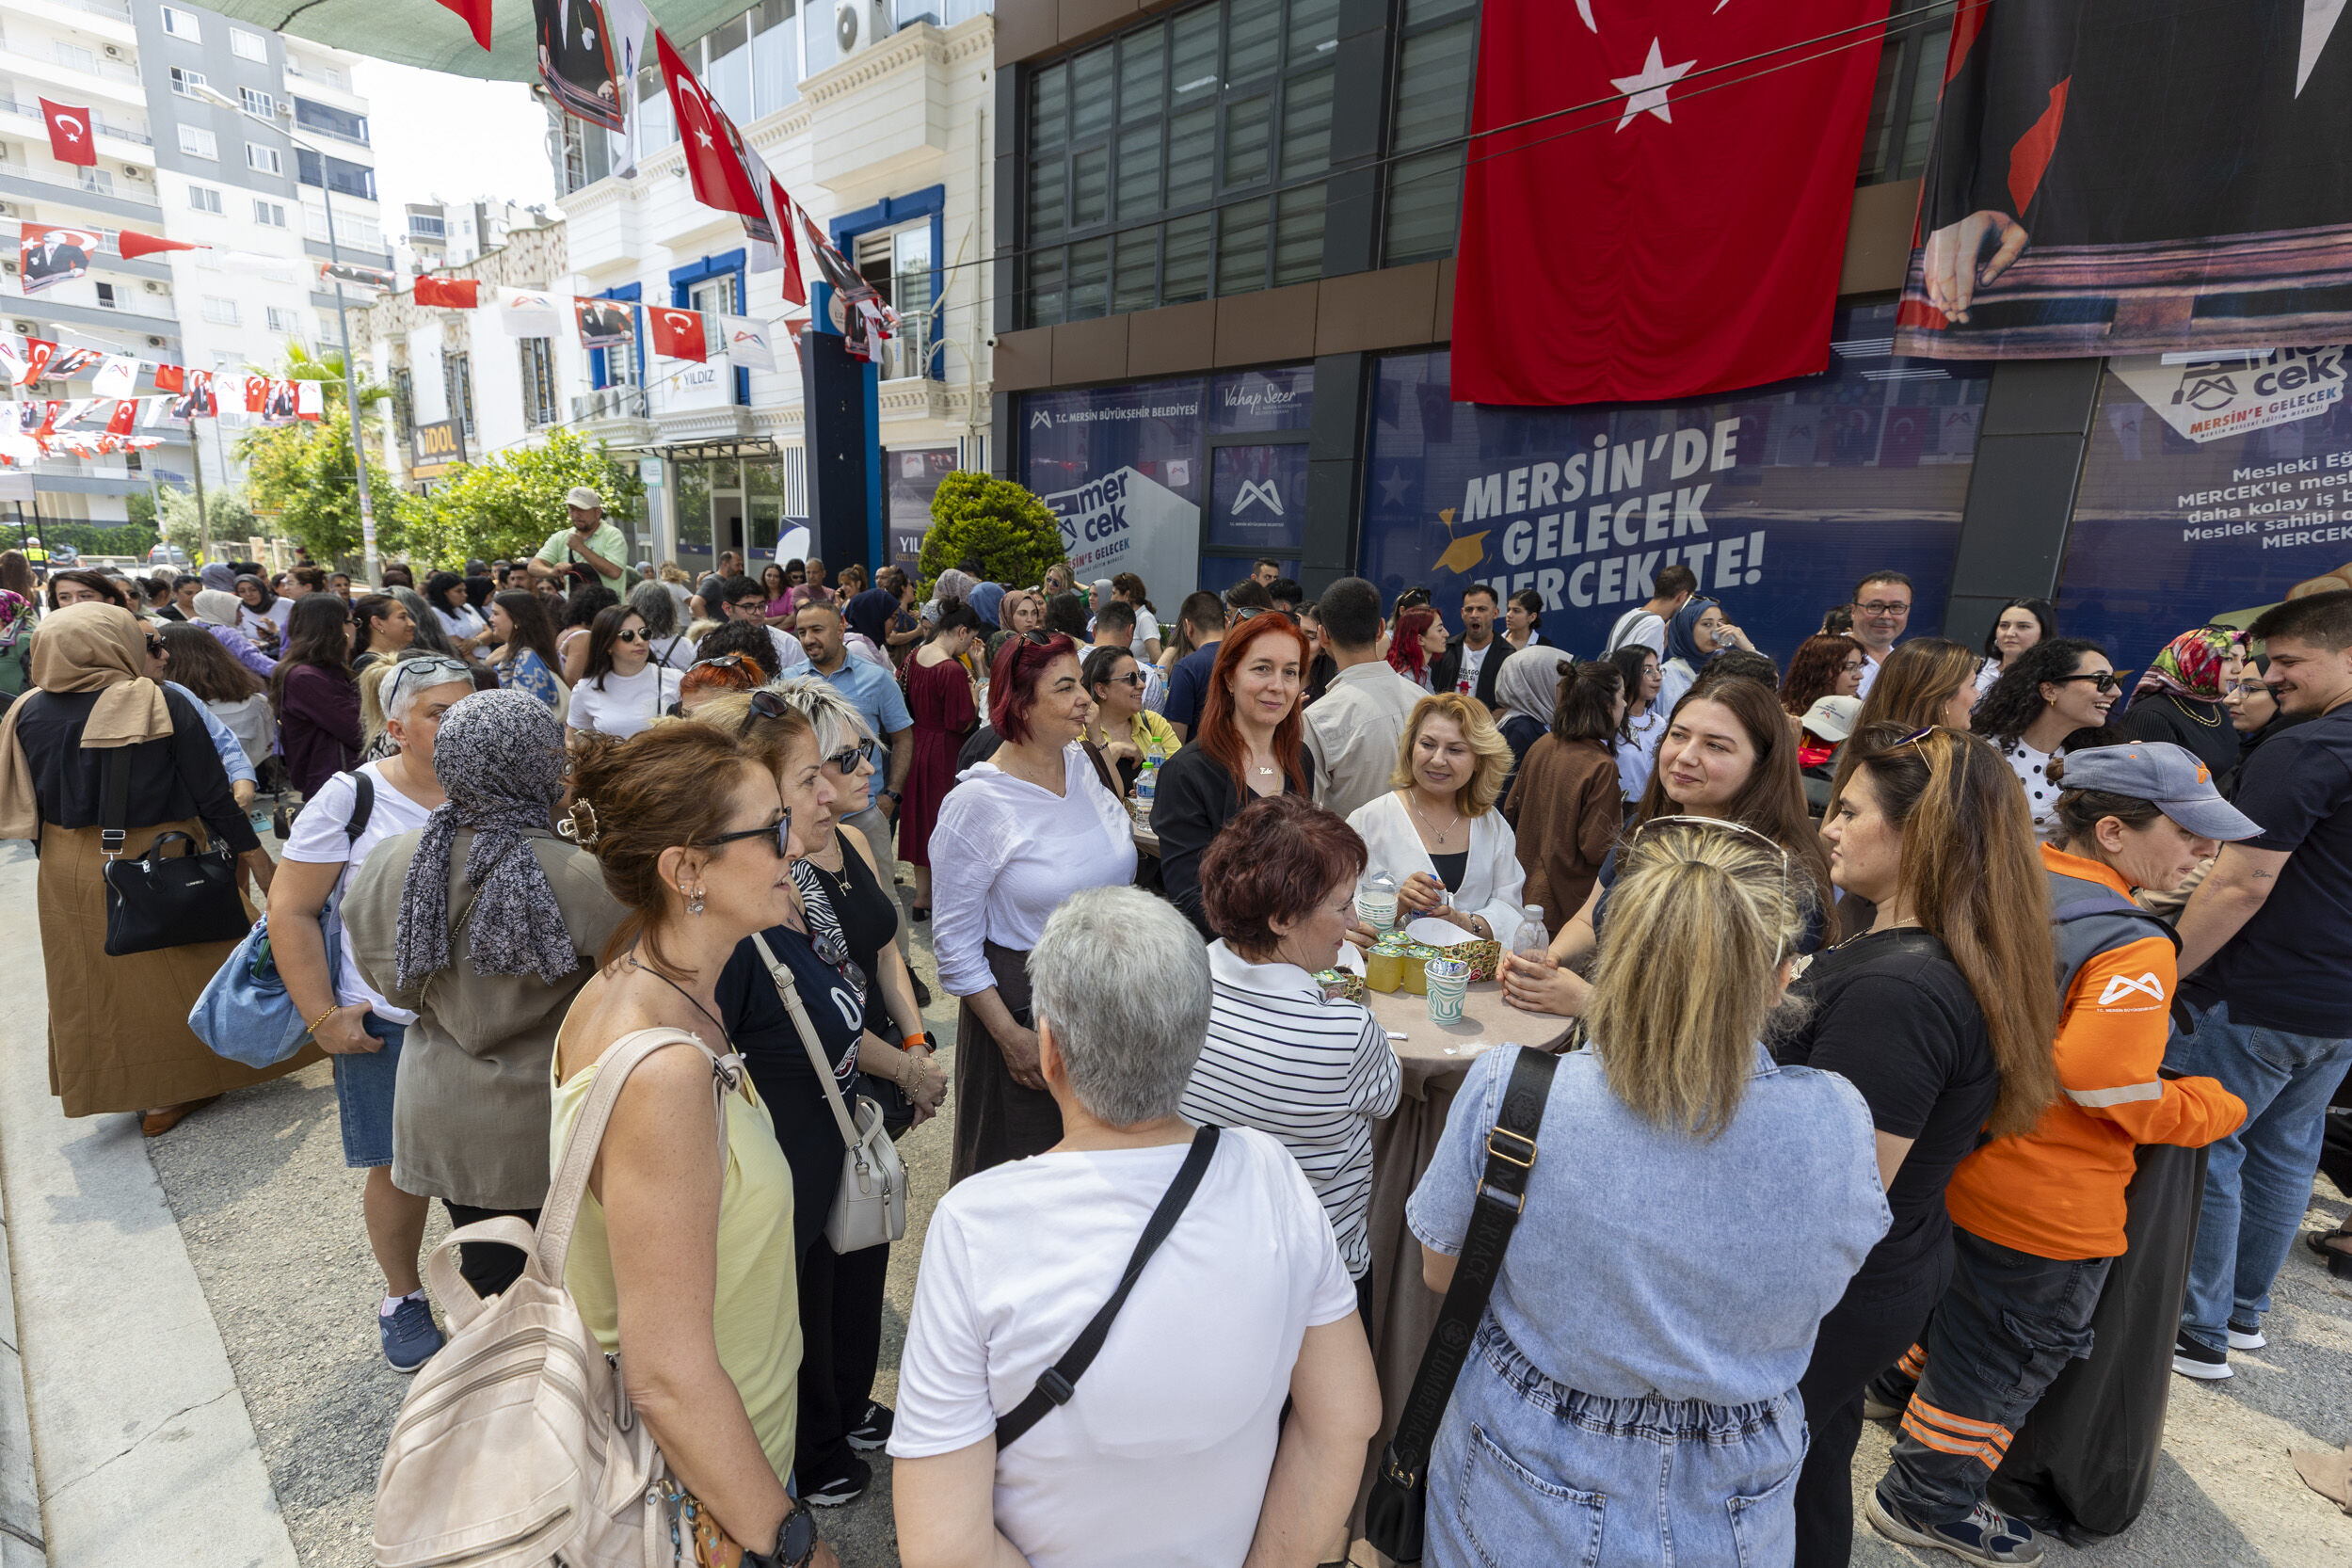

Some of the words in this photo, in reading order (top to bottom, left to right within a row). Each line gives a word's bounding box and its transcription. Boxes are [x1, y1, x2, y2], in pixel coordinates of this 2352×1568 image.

[683, 369, 714, 385] YILDIZ
[2253, 355, 2340, 397] cek
[1069, 409, 1098, 423] MERSİN
[1099, 405, 1150, 422] BÜYÜKŞEHİR
[1151, 402, 1198, 417] BELEDİYESİ
[1224, 384, 1262, 415] Vahap
[2189, 406, 2263, 435] MERSİN'E
[2268, 386, 2338, 414] GELECEK
[2232, 456, 2318, 483] Mesleki
[1079, 472, 1128, 515] mer
[2177, 481, 2292, 508] MERCEK'le
[2187, 506, 2241, 524] daha
[2248, 497, 2309, 517] kolay
[2315, 492, 2335, 508] iş
[1084, 503, 1130, 542] cek
[1502, 483, 1713, 566] GELECEK
[2183, 520, 2258, 542] Meslek
[2264, 509, 2334, 532] sahibi
[899, 536, 921, 552] YIL
[1095, 536, 1130, 560] GELECEK
